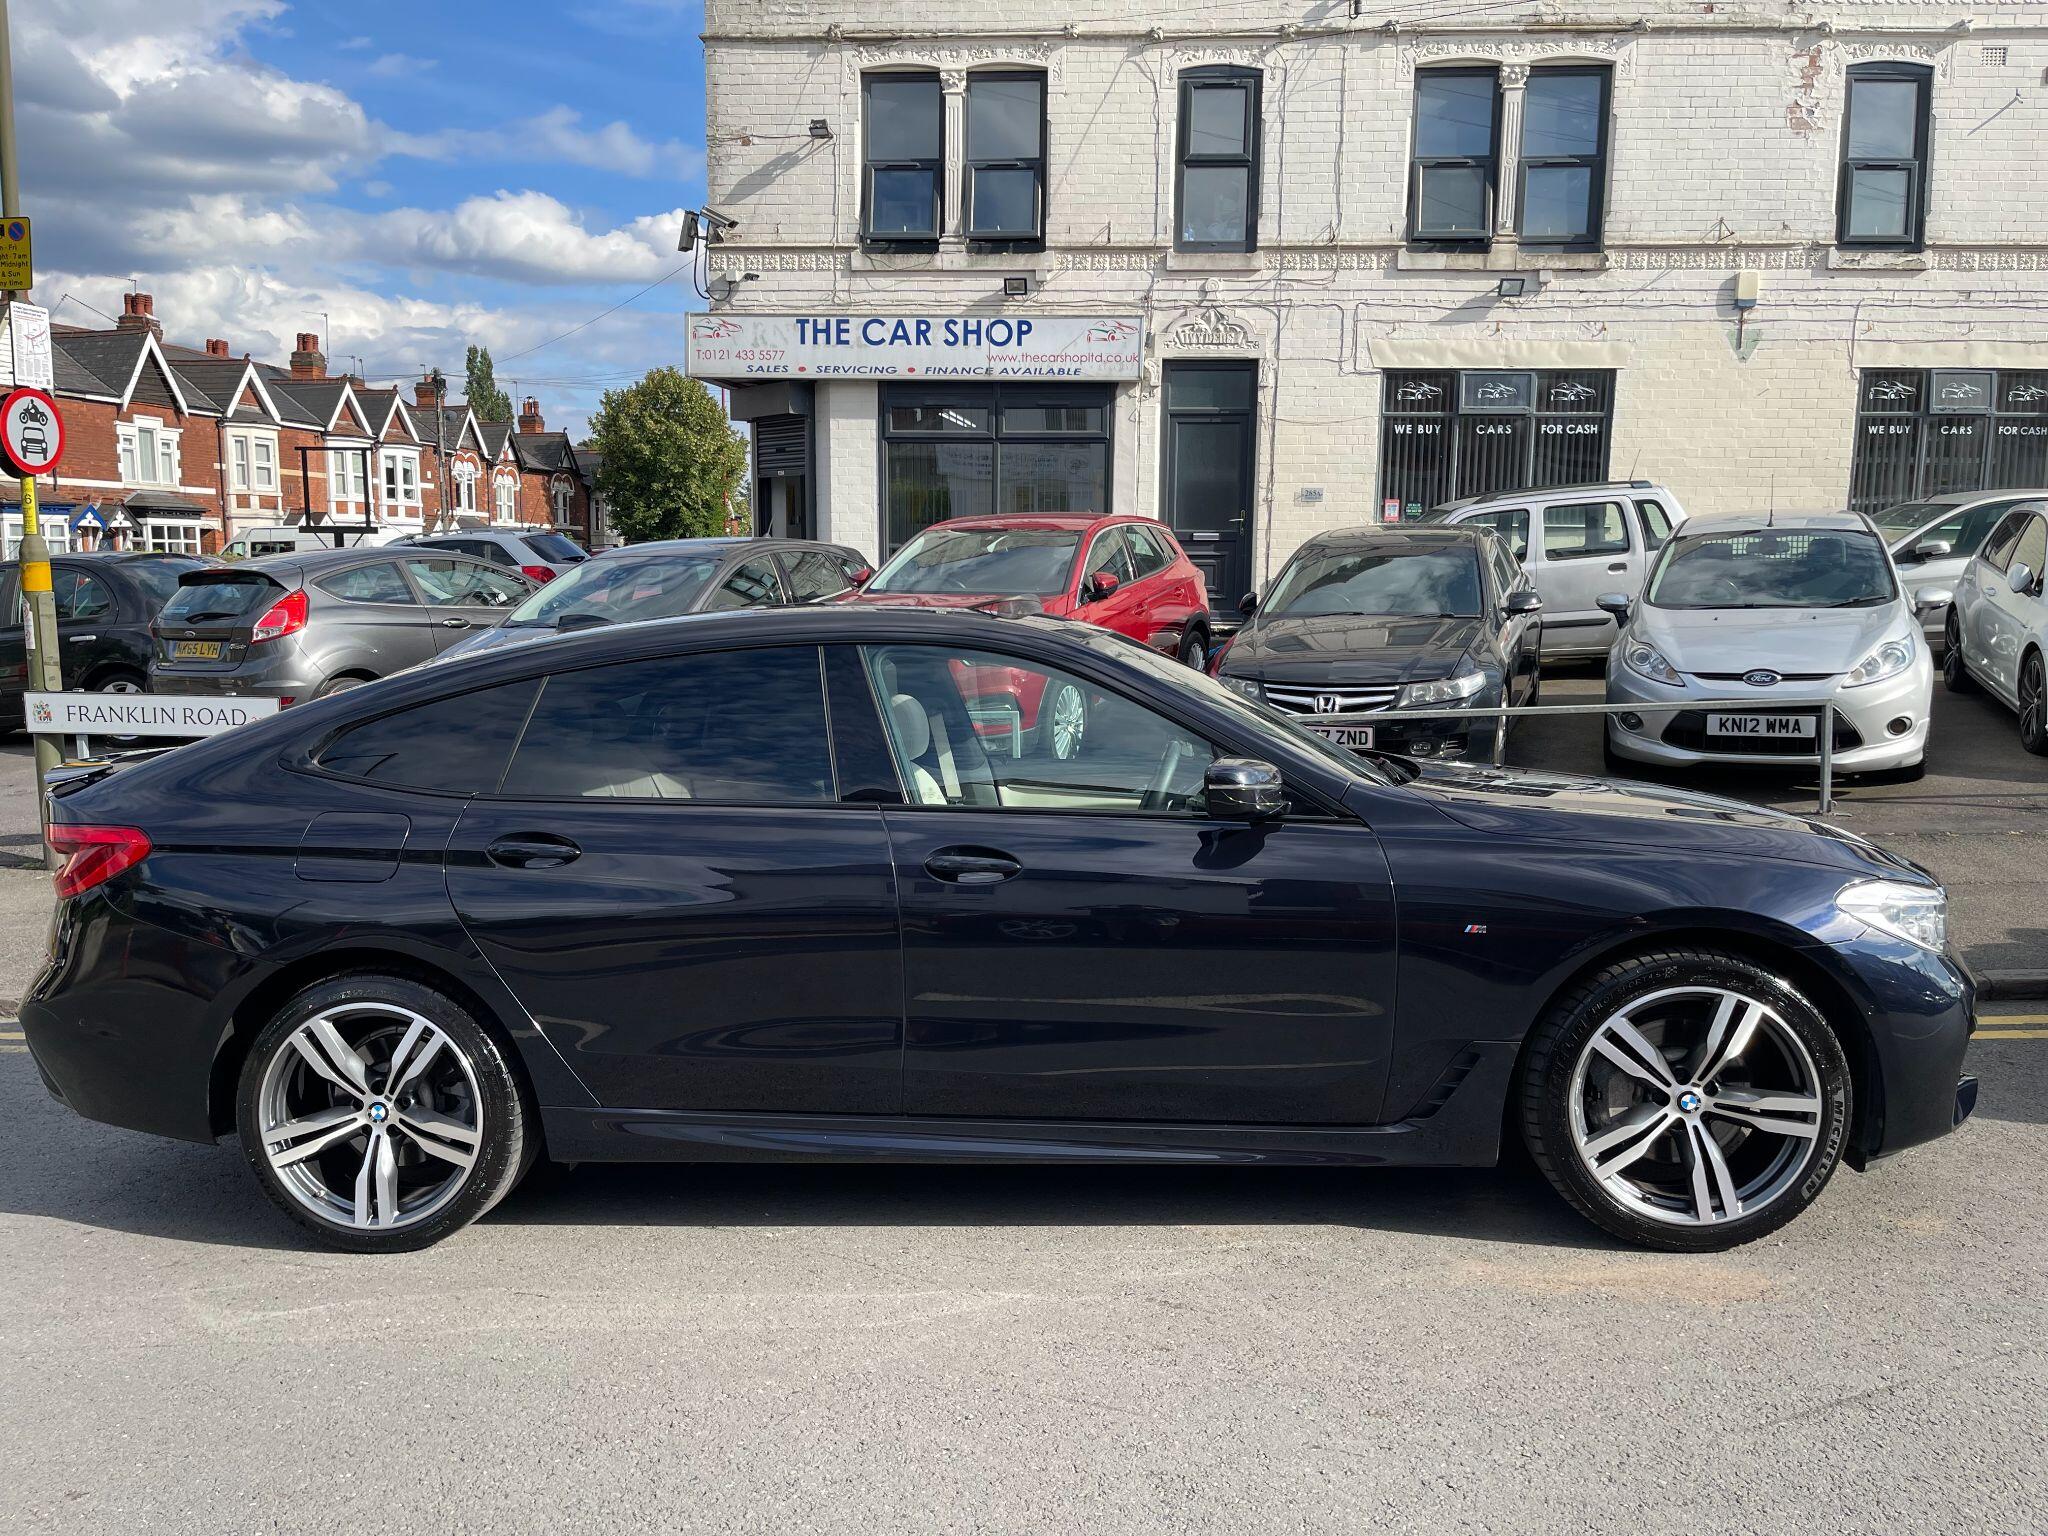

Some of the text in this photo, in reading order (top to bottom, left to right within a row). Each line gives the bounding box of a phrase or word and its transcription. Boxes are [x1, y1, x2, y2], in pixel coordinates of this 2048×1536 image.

[795, 318, 850, 346] THE
[862, 318, 932, 347] CAR
[943, 318, 1033, 347] SHOP
[695, 349, 785, 361] T:0121 433 5577
[986, 352, 1140, 364] www.thecarshopltd.co.uk
[746, 364, 1082, 376] SALES SERVICING FINANCE AVAILABLE
[1394, 424, 1598, 435] WE BUY CARS FOR CASH
[1868, 425, 2047, 436] WE BUY CARS FOR CASH
[25, 493, 32, 505] 6
[66, 705, 176, 724] FRANKLIN
[183, 707, 247, 726] ROAD
[1718, 717, 1802, 735] KN12 WMA
[1335, 730, 1369, 746] ZND
[1805, 1100, 1845, 1195] MICHELIN
